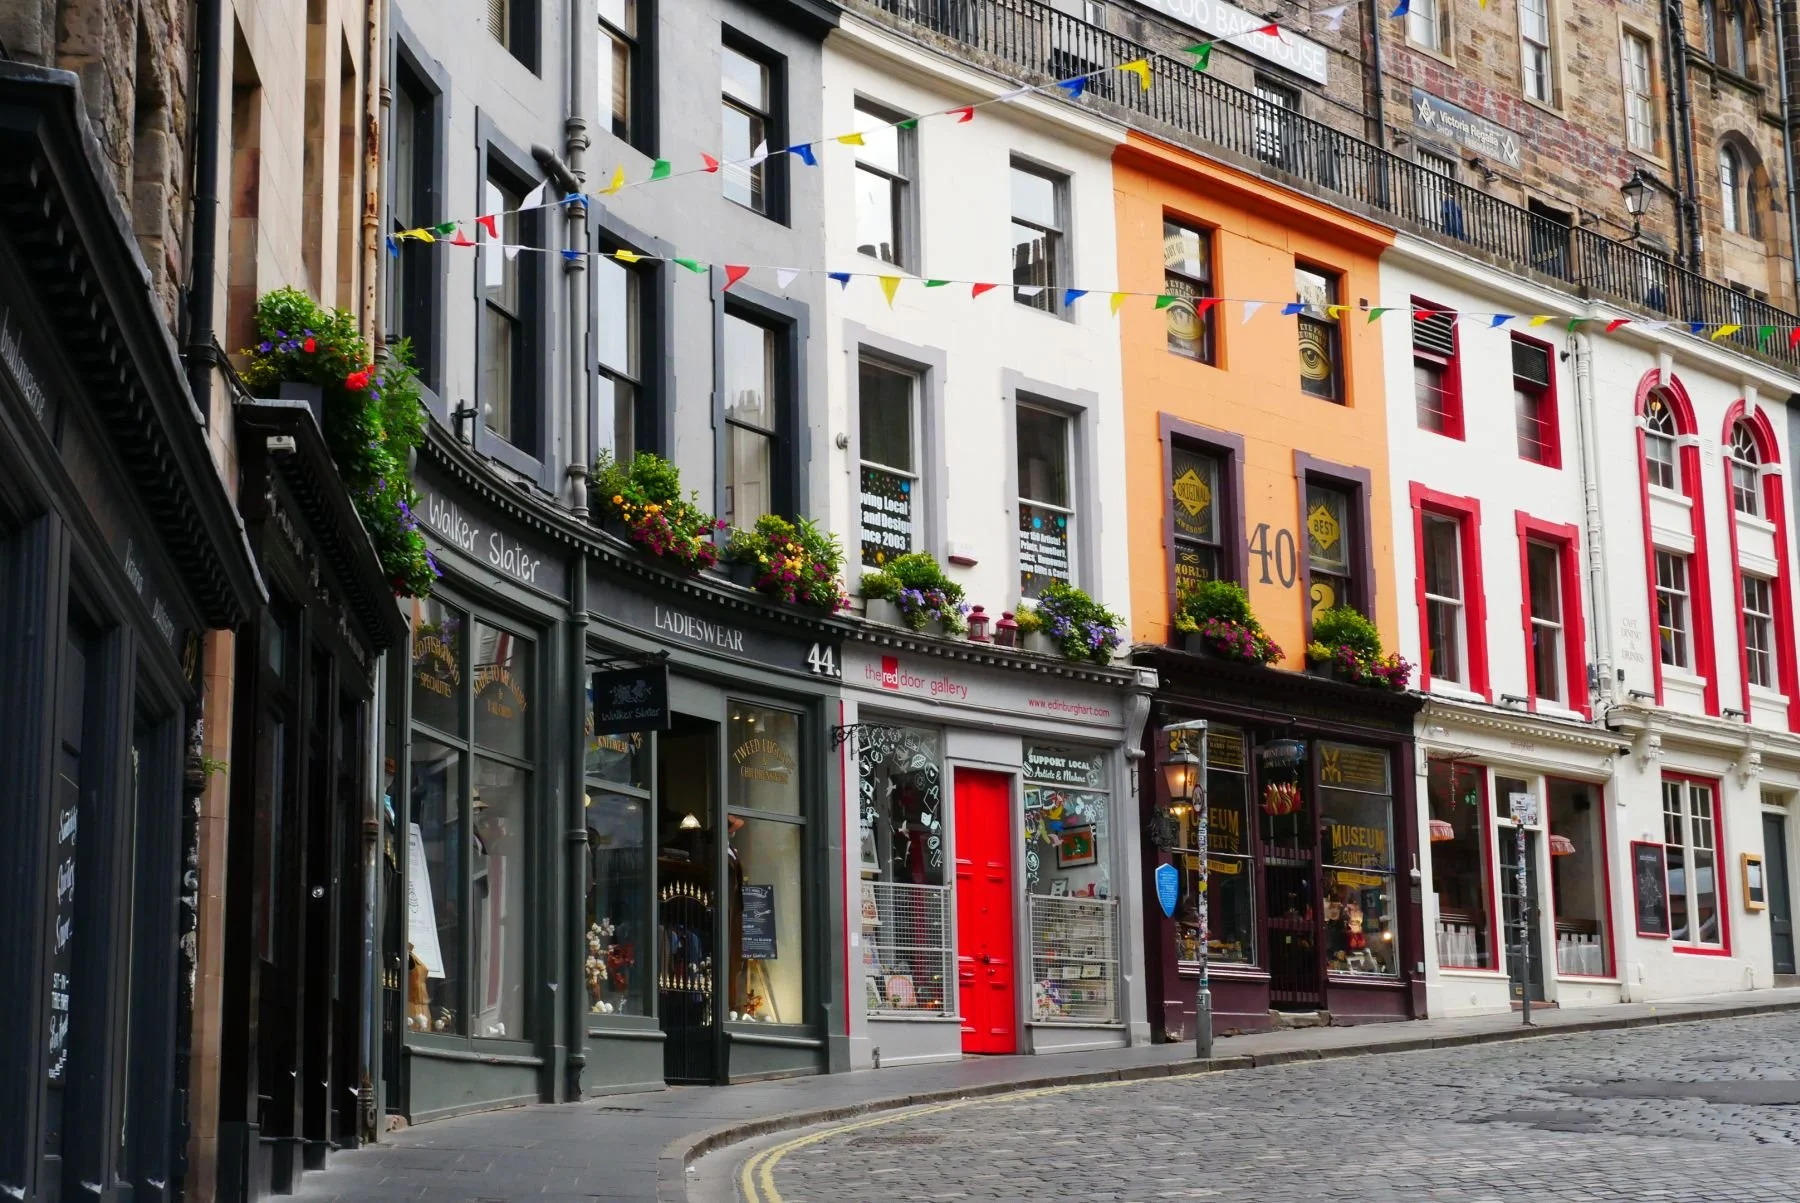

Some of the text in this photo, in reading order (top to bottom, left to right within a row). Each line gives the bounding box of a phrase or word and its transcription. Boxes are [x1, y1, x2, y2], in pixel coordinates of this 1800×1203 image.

[1215, 5, 1324, 77] BAKEHOUSE
[1439, 110, 1469, 133] Victoria
[1470, 124, 1498, 147] Regalia
[883, 495, 908, 515] Local
[863, 510, 881, 527] and
[1313, 519, 1334, 536] BEST
[429, 492, 541, 583] Walker Slater
[882, 530, 906, 550] 2003
[1249, 522, 1297, 589] 40
[655, 606, 744, 652] LADIESWEAR
[865, 663, 968, 699] the red door gallery
[601, 707, 661, 722] Walker Slater
[1028, 699, 1111, 717] www.edinburghart.com
[1028, 754, 1091, 770] SUPPORT LOCAL
[1331, 824, 1386, 854] MUSEUM
